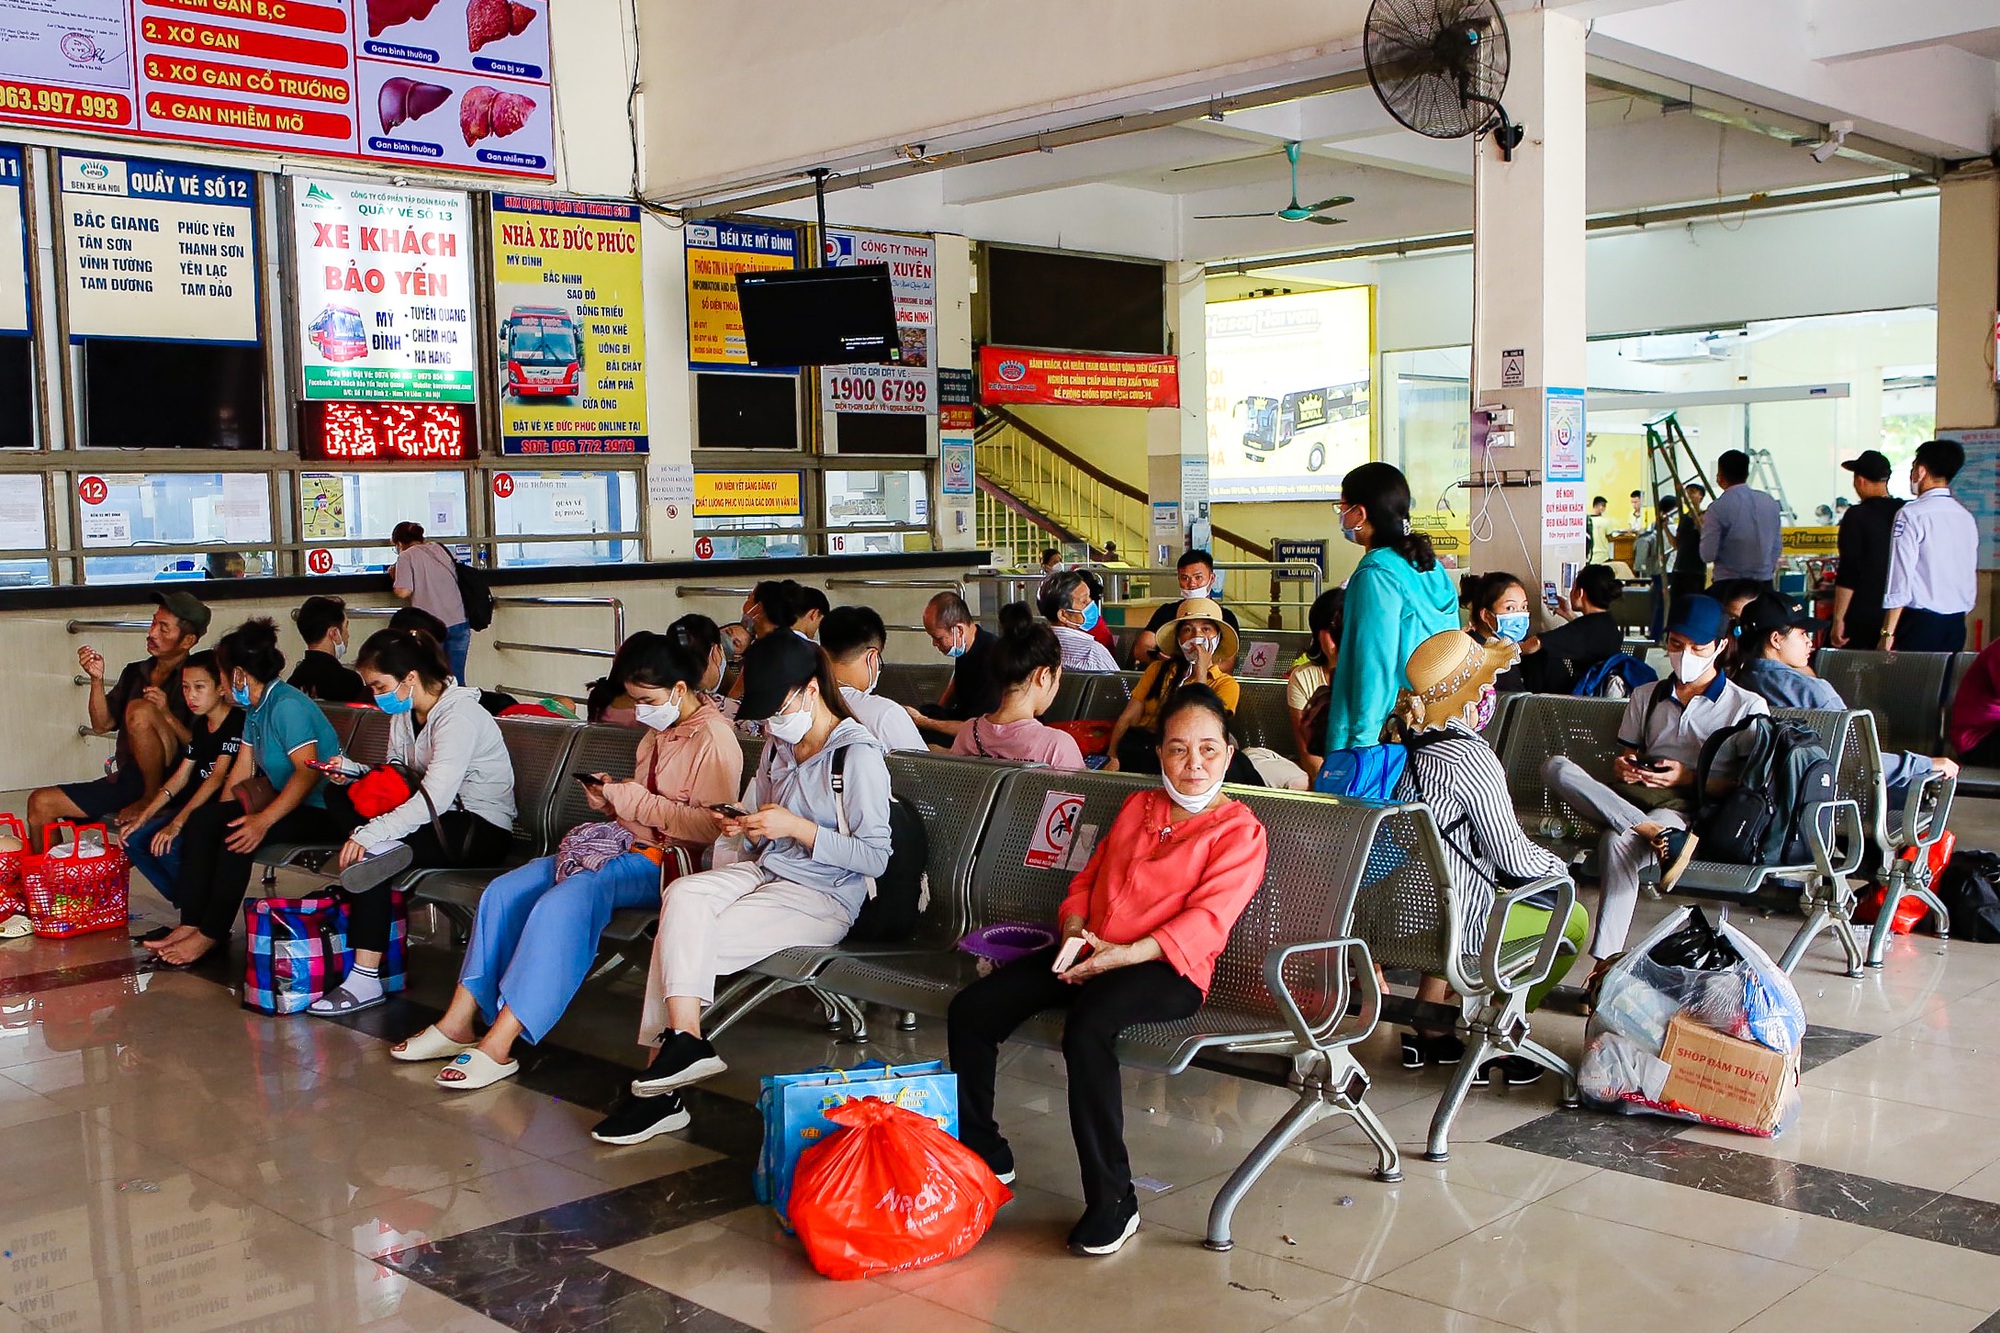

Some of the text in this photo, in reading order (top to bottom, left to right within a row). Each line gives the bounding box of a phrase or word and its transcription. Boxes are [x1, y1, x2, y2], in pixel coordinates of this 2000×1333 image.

[213, 0, 286, 20] GAN B,C
[145, 22, 240, 50] 2. XƠ GAN
[372, 44, 433, 61] Gan bình thường
[491, 61, 507, 72] Gan
[508, 62, 516, 73] bị
[148, 61, 347, 99] 3. XƠ GAN CỔ TRƯỚNG
[150, 101, 304, 131] 4. GAN NHIỄM MỠ
[376, 140, 437, 157] Gan bình thường
[487, 152, 502, 162] Gan
[0, 158, 18, 177] 11
[87, 182, 96, 191] XE
[131, 169, 248, 199] QUẦY VÉ SỐ 12
[369, 192, 377, 201] TY
[73, 209, 159, 233] BẮC GIANG
[398, 206, 414, 218] VÉ
[439, 212, 453, 222] 13
[177, 219, 235, 238] PHÚC YÊN
[502, 221, 635, 253] NHÀ XE ĐỨC PHÚC
[78, 234, 133, 251] TÂN SƠN
[311, 222, 457, 258] XE KHÁCH
[720, 228, 792, 251] BẾN XE MỸ ĐÌNH
[861, 239, 928, 257] CÔNG TY TNHH
[178, 242, 245, 259] THANH SƠN
[79, 254, 153, 273] VĨNH TƯỜNG
[522, 256, 542, 266] ĐÌNH
[893, 261, 931, 278] XUYÊN
[179, 260, 228, 281] YÊN LẠC
[325, 259, 448, 297] BẢO YẾN
[562, 274, 582, 284] NINH
[80, 276, 153, 293] TAM DƯƠNG
[180, 279, 233, 299] TAM ĐẢO
[567, 289, 582, 299] SAO
[439, 308, 466, 322] QUANG
[592, 324, 610, 337] MẠO
[372, 331, 402, 350] ĐÌNH
[414, 350, 451, 364] NA HANG
[831, 377, 876, 401] 1900
[882, 379, 926, 402] 6799
[513, 419, 641, 433] ĐẶT VÉ XE ĐỨC PHÚC ONLINE TẠI
[552, 440, 635, 453] 096 772 3979
[83, 482, 103, 498] 12
[496, 478, 512, 492] 14
[1569, 517, 1583, 526] TRANG
[697, 543, 711, 554] 15
[832, 536, 844, 551] 16
[1297, 546, 1320, 554] KHÁCH
[311, 553, 330, 570] 13
[1677, 1047, 1706, 1063] SHOP
